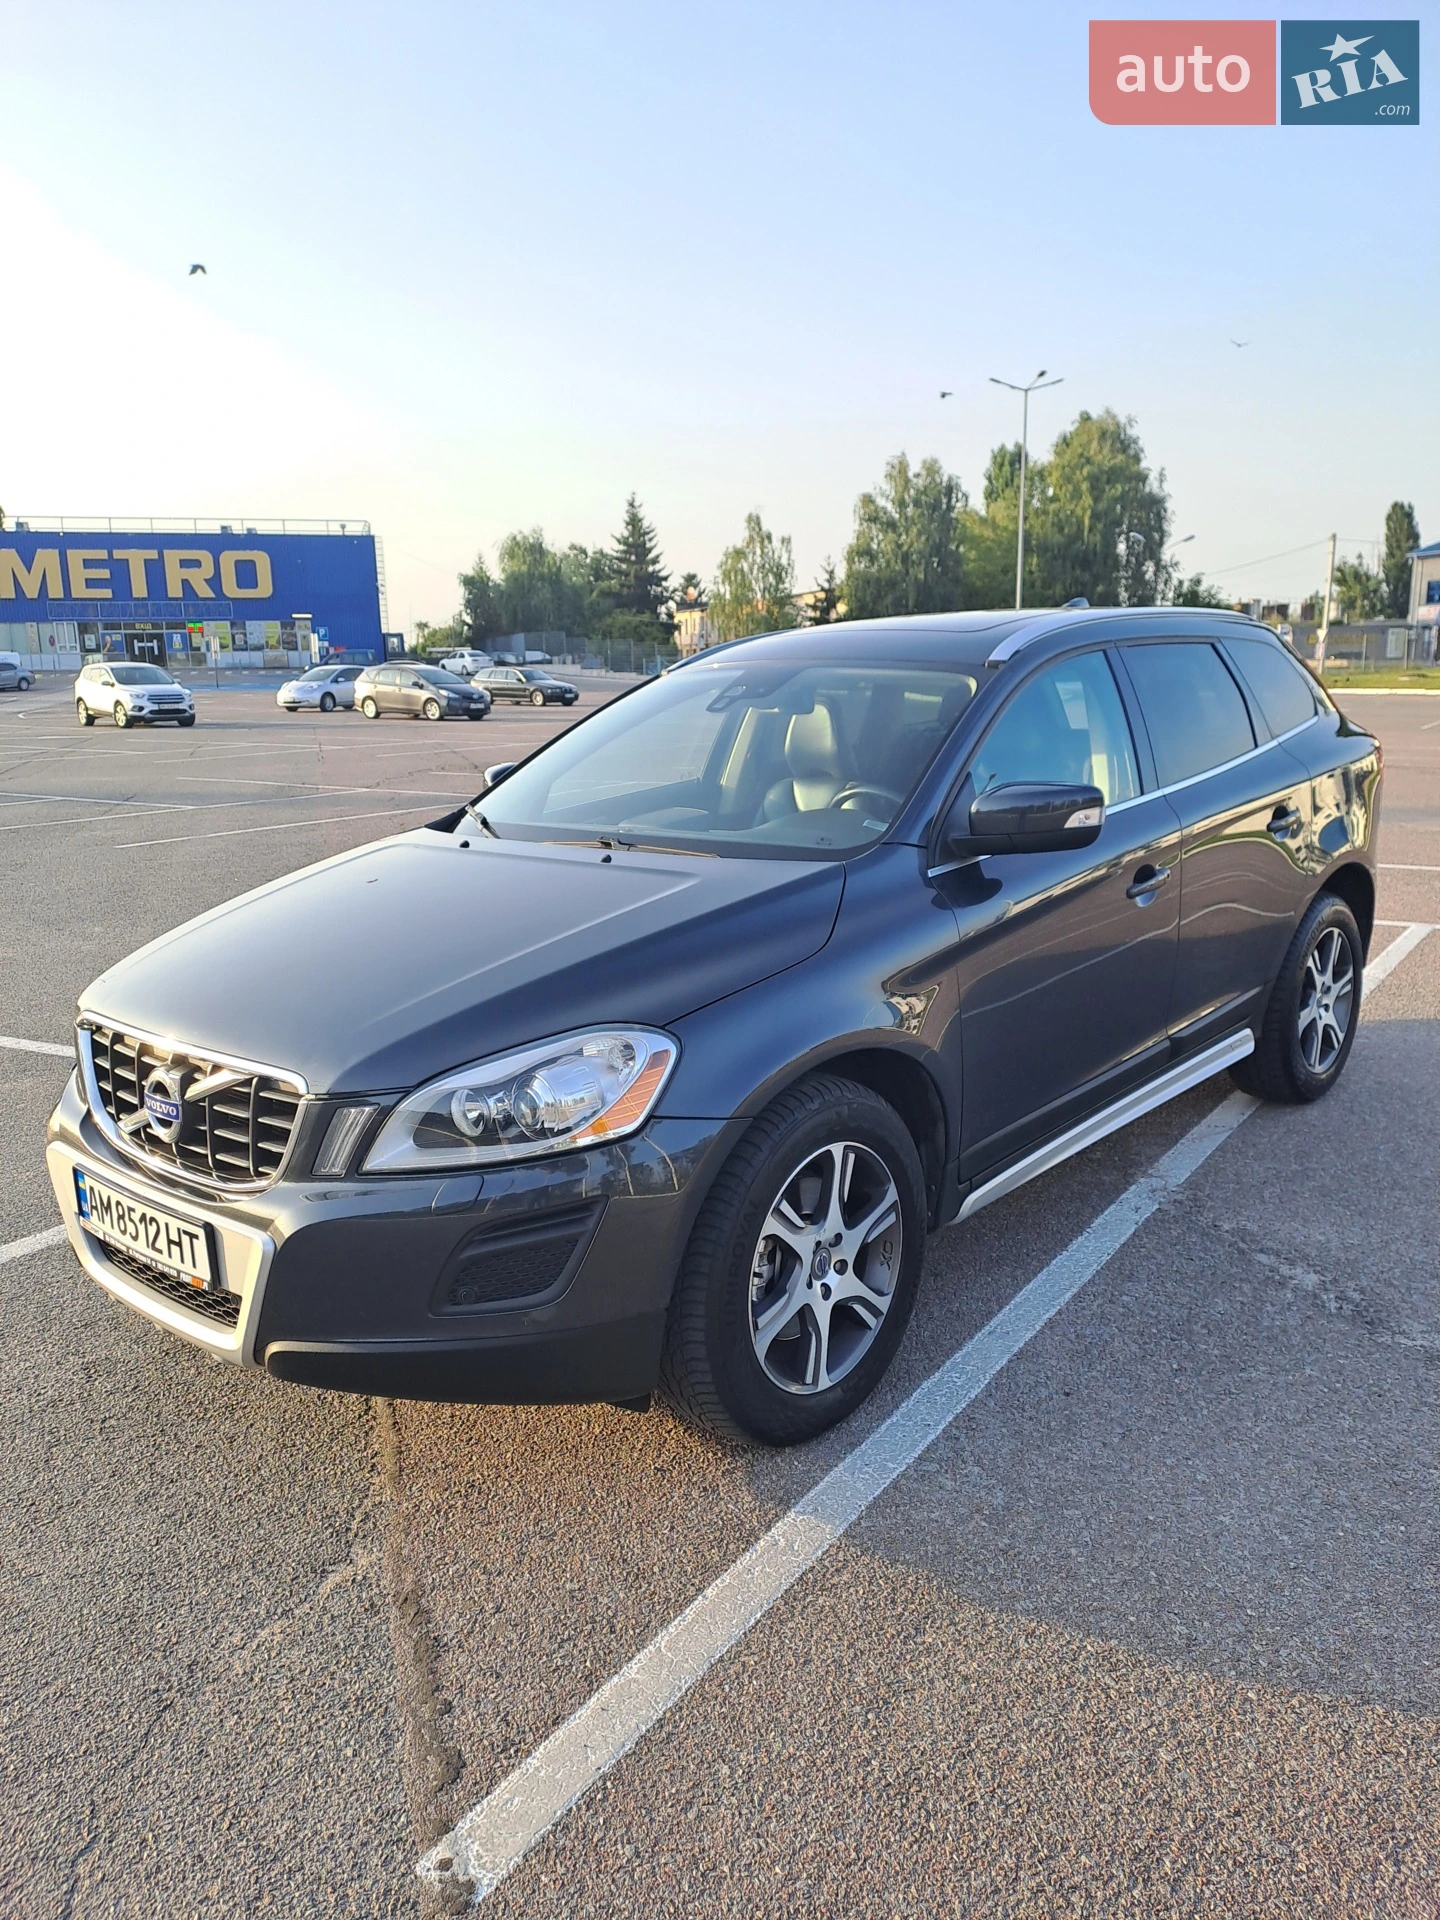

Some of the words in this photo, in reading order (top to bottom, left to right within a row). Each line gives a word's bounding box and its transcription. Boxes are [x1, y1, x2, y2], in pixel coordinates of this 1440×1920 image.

[0, 548, 273, 598] METRO
[146, 1098, 177, 1116] VOLVO
[725, 1198, 764, 1327] UNIROYAL
